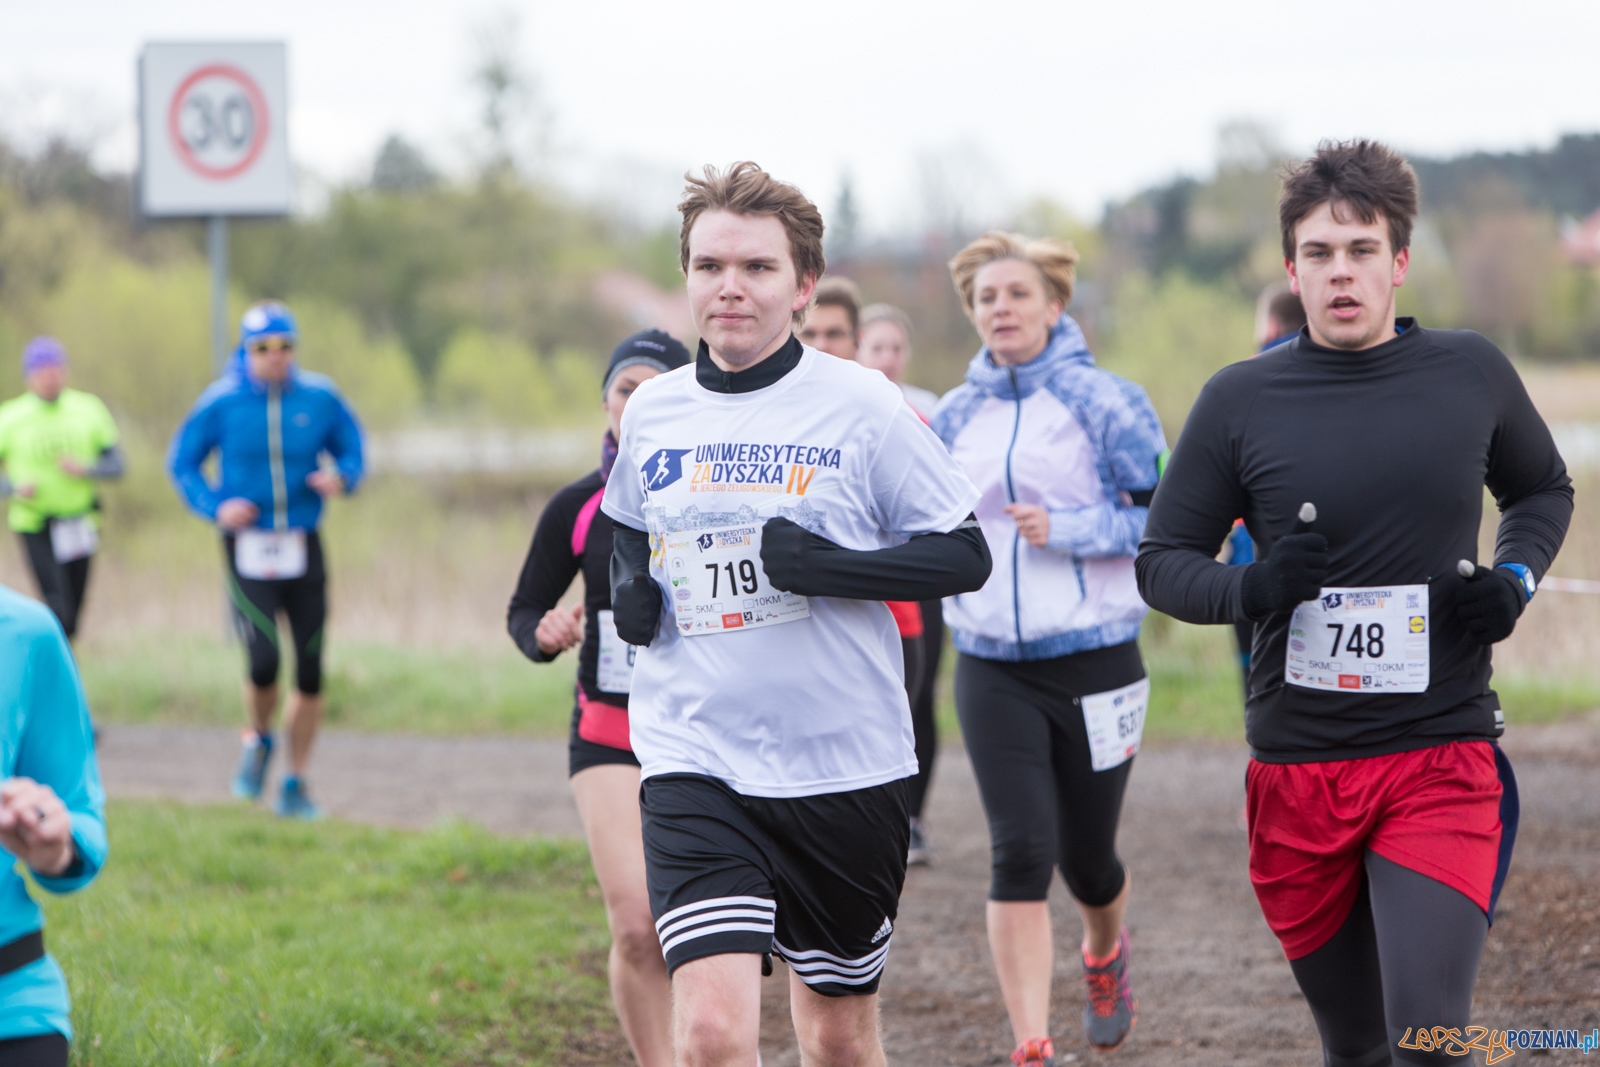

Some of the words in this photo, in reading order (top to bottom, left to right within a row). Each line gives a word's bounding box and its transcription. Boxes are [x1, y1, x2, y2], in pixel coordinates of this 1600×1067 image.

[184, 94, 256, 151] 30
[695, 442, 842, 469] UNIWERSYTECKA
[691, 463, 783, 485] ZADYSZKA
[786, 464, 816, 496] IV
[700, 483, 726, 493] JERZEGO
[714, 527, 757, 539] UNIWERSYTECKA
[705, 559, 759, 599] 719
[755, 595, 782, 606] 10KM
[696, 604, 714, 614] 5KM
[1326, 623, 1385, 659] 748
[1309, 660, 1330, 670] 5KM
[1377, 663, 1405, 672] 10KM
